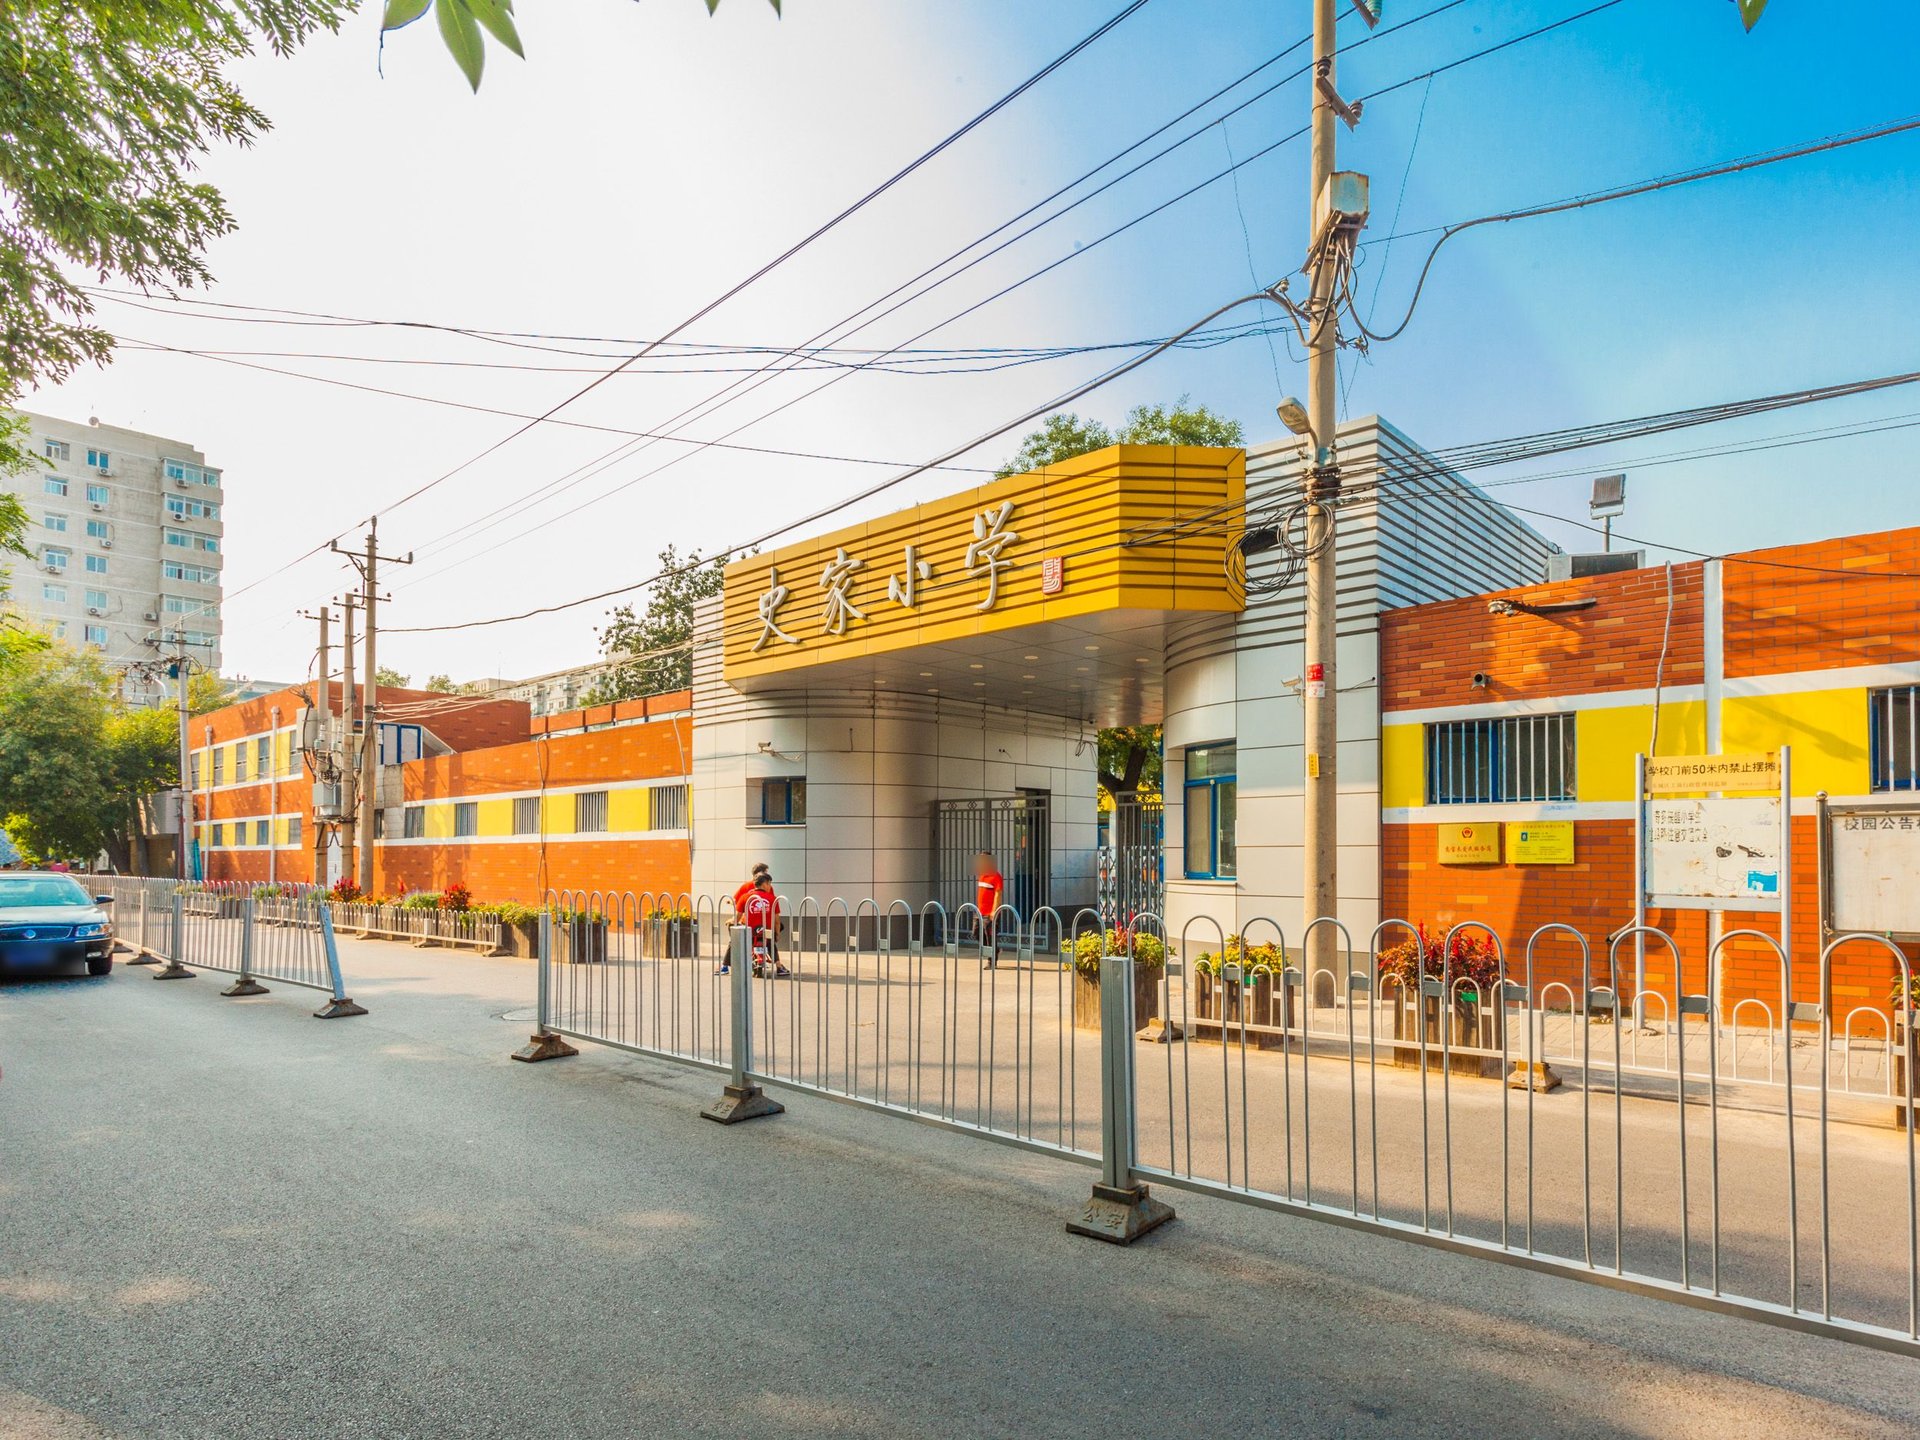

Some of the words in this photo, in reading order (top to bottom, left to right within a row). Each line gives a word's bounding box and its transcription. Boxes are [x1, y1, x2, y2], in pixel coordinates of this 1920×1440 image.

[751, 500, 1020, 653] 史家小学
[1648, 761, 1776, 777] 学校门前50米内禁止摆摊
